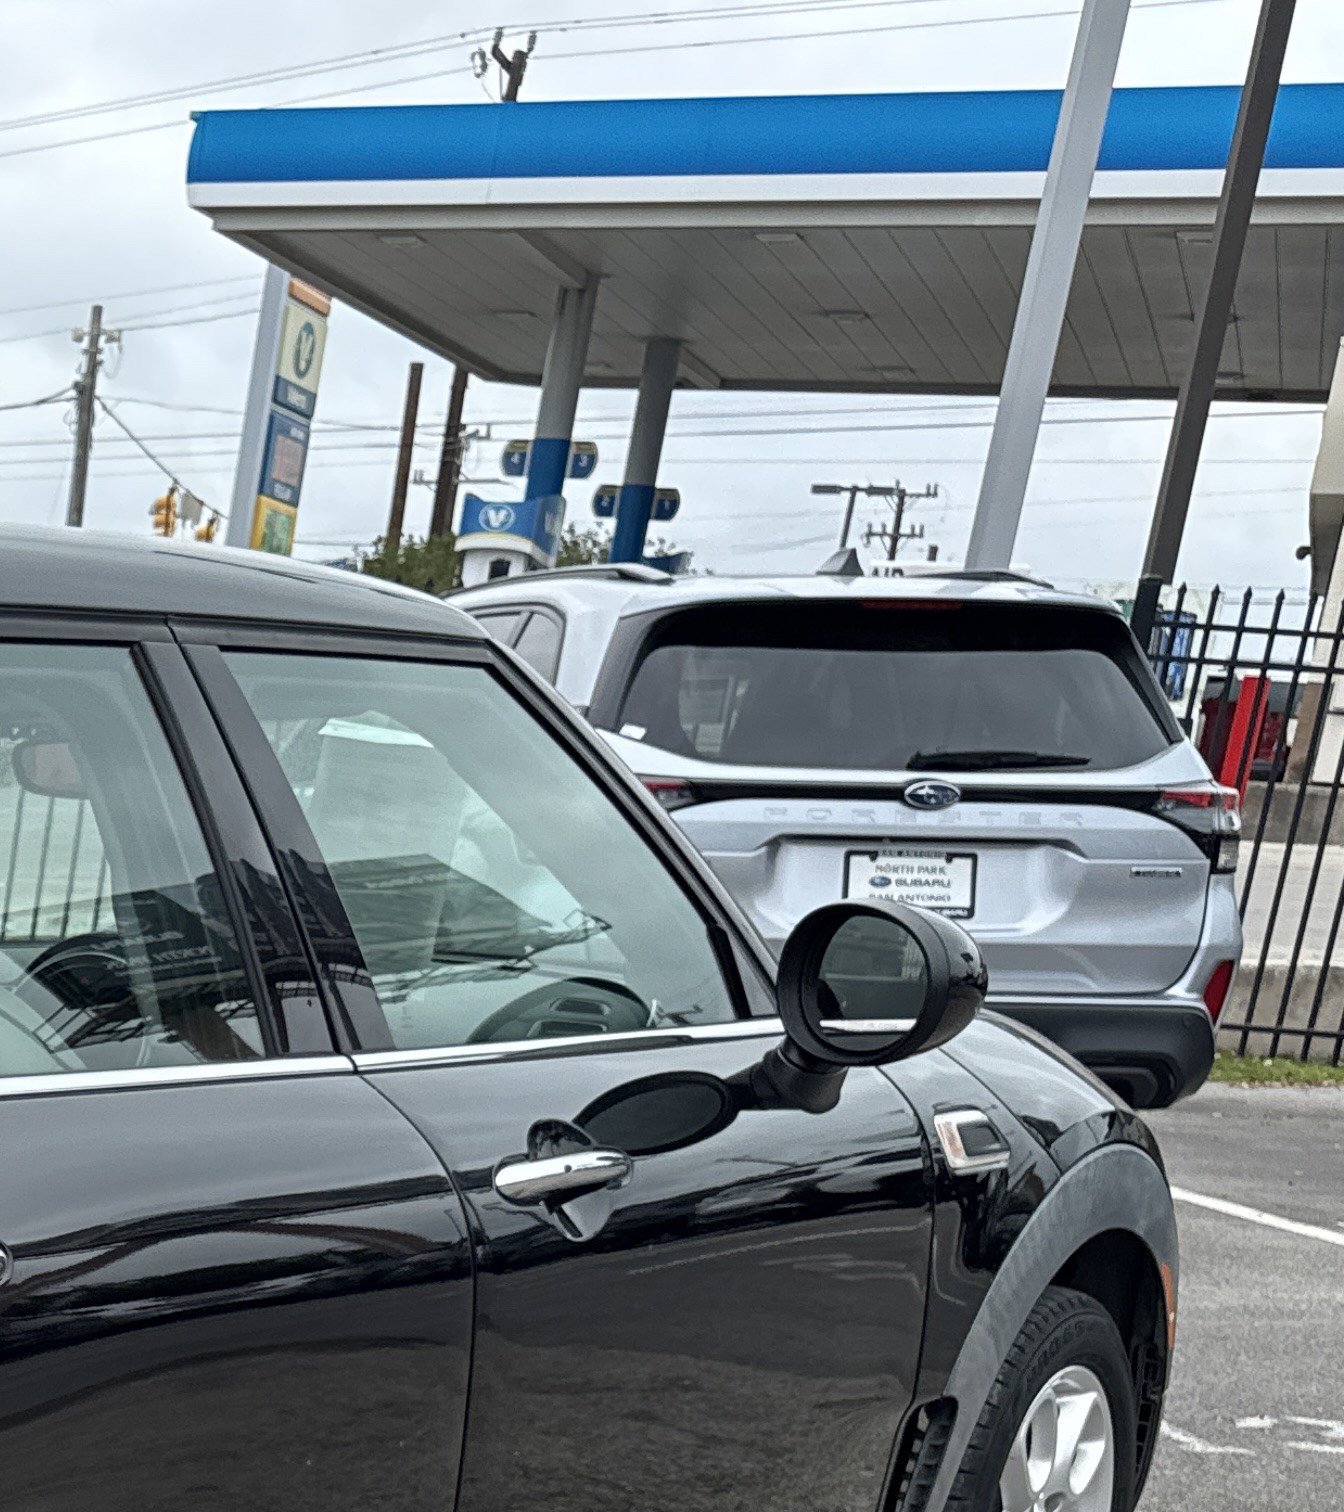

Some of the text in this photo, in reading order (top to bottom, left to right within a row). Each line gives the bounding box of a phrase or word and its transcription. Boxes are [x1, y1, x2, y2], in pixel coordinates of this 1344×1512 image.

[579, 455, 588, 467] 3
[875, 863, 947, 877] NORTH PARK
[895, 878, 951, 889] SUBARU
